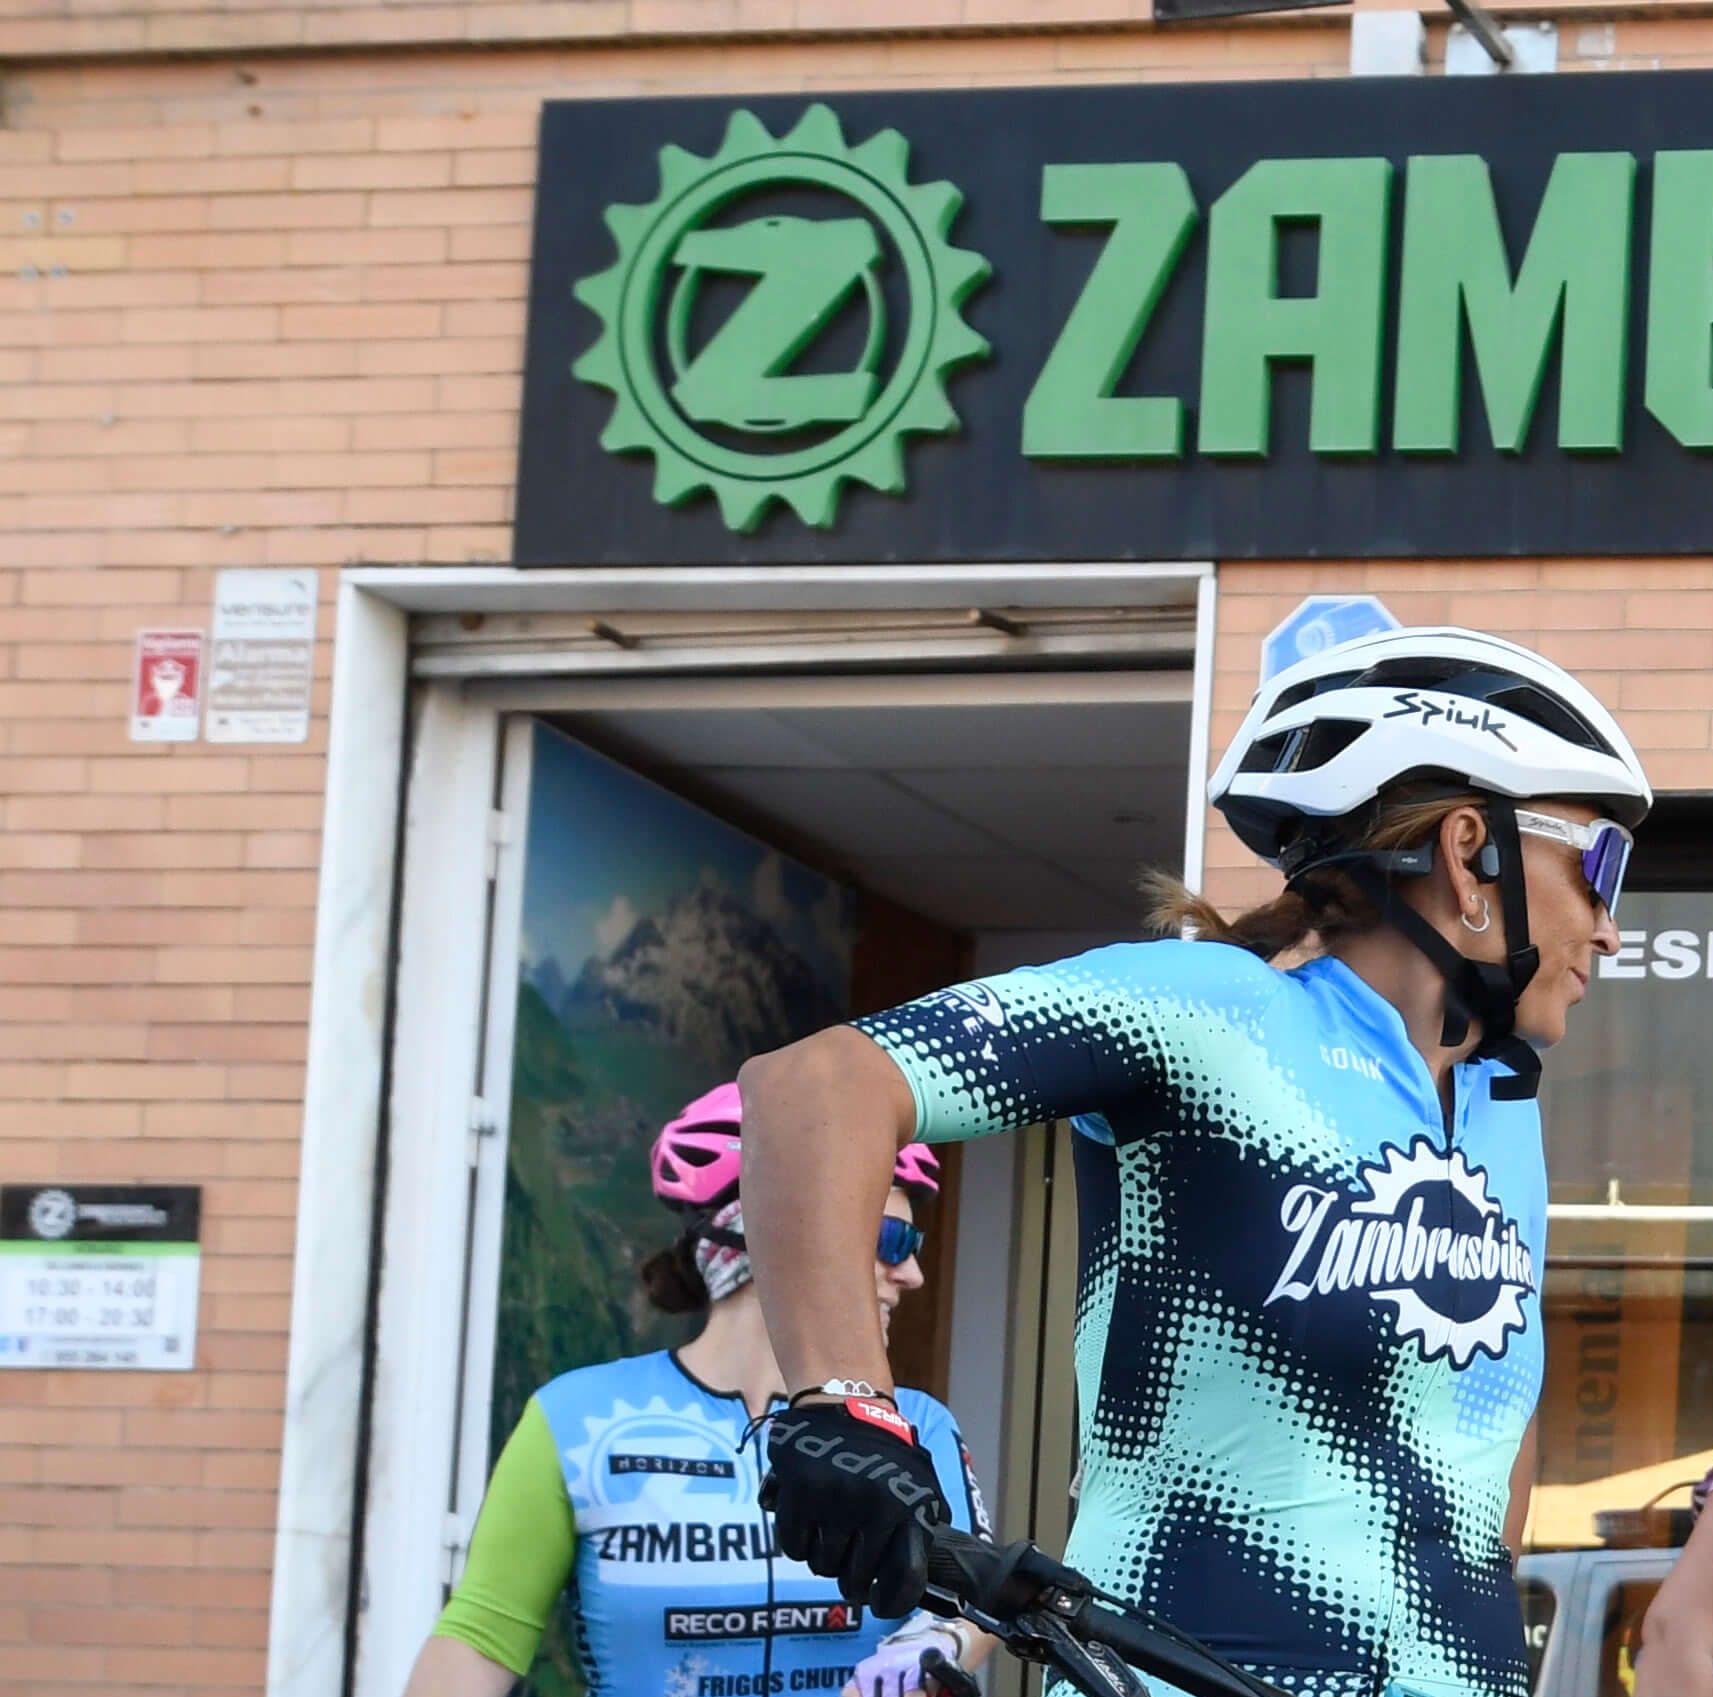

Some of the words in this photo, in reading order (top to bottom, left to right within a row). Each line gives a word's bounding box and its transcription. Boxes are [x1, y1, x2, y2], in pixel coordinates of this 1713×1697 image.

[1384, 692, 1518, 753] Spiuk
[1263, 1184, 1536, 1308] Zambrusbike
[617, 1458, 726, 1476] HORIZON
[598, 1522, 782, 1564] ZAMBRU
[669, 1612, 746, 1635] RECO
[698, 1671, 785, 1697] FRIGOS
